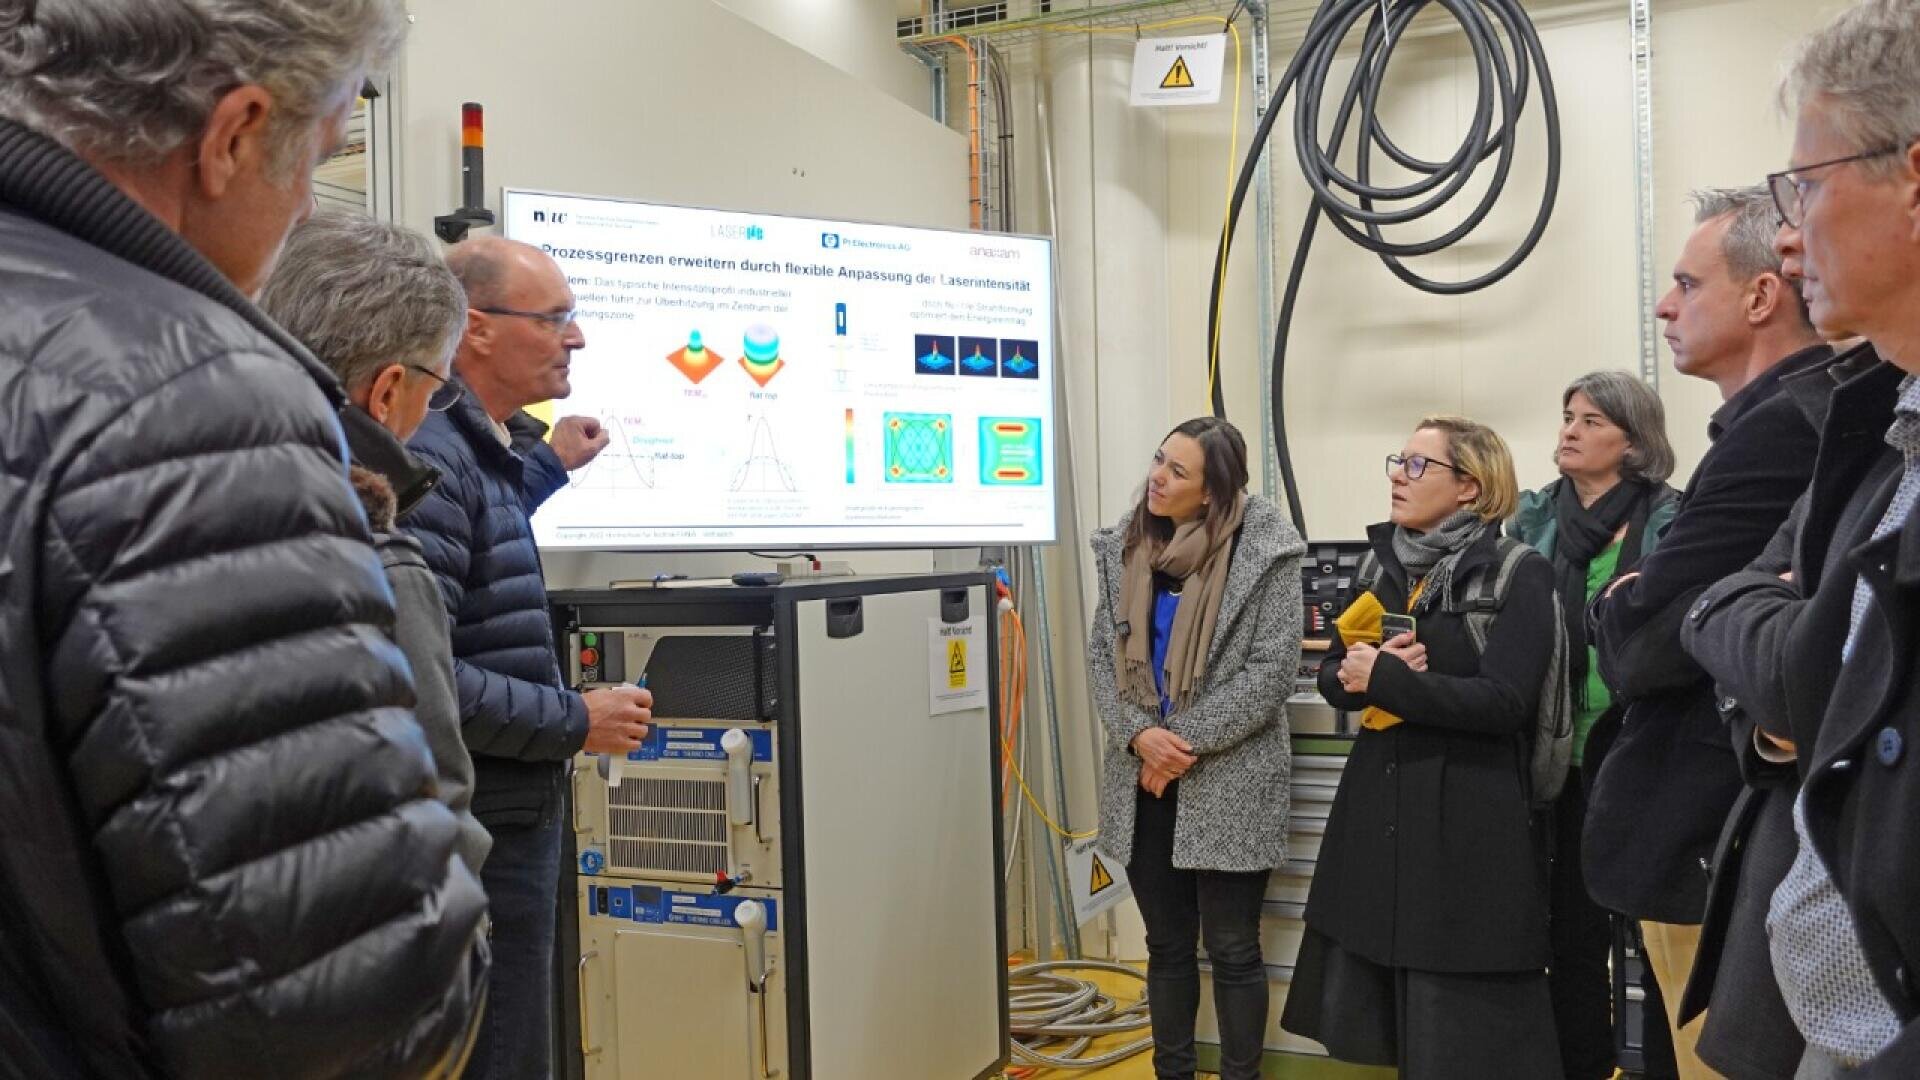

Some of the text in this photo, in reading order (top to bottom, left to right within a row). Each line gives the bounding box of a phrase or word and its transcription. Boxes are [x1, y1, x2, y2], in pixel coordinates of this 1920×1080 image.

[542, 243, 1031, 292] Prozessgrenzen erweitern durch flexible Anpassung der Laserintensität
[617, 279, 659, 290] typische
